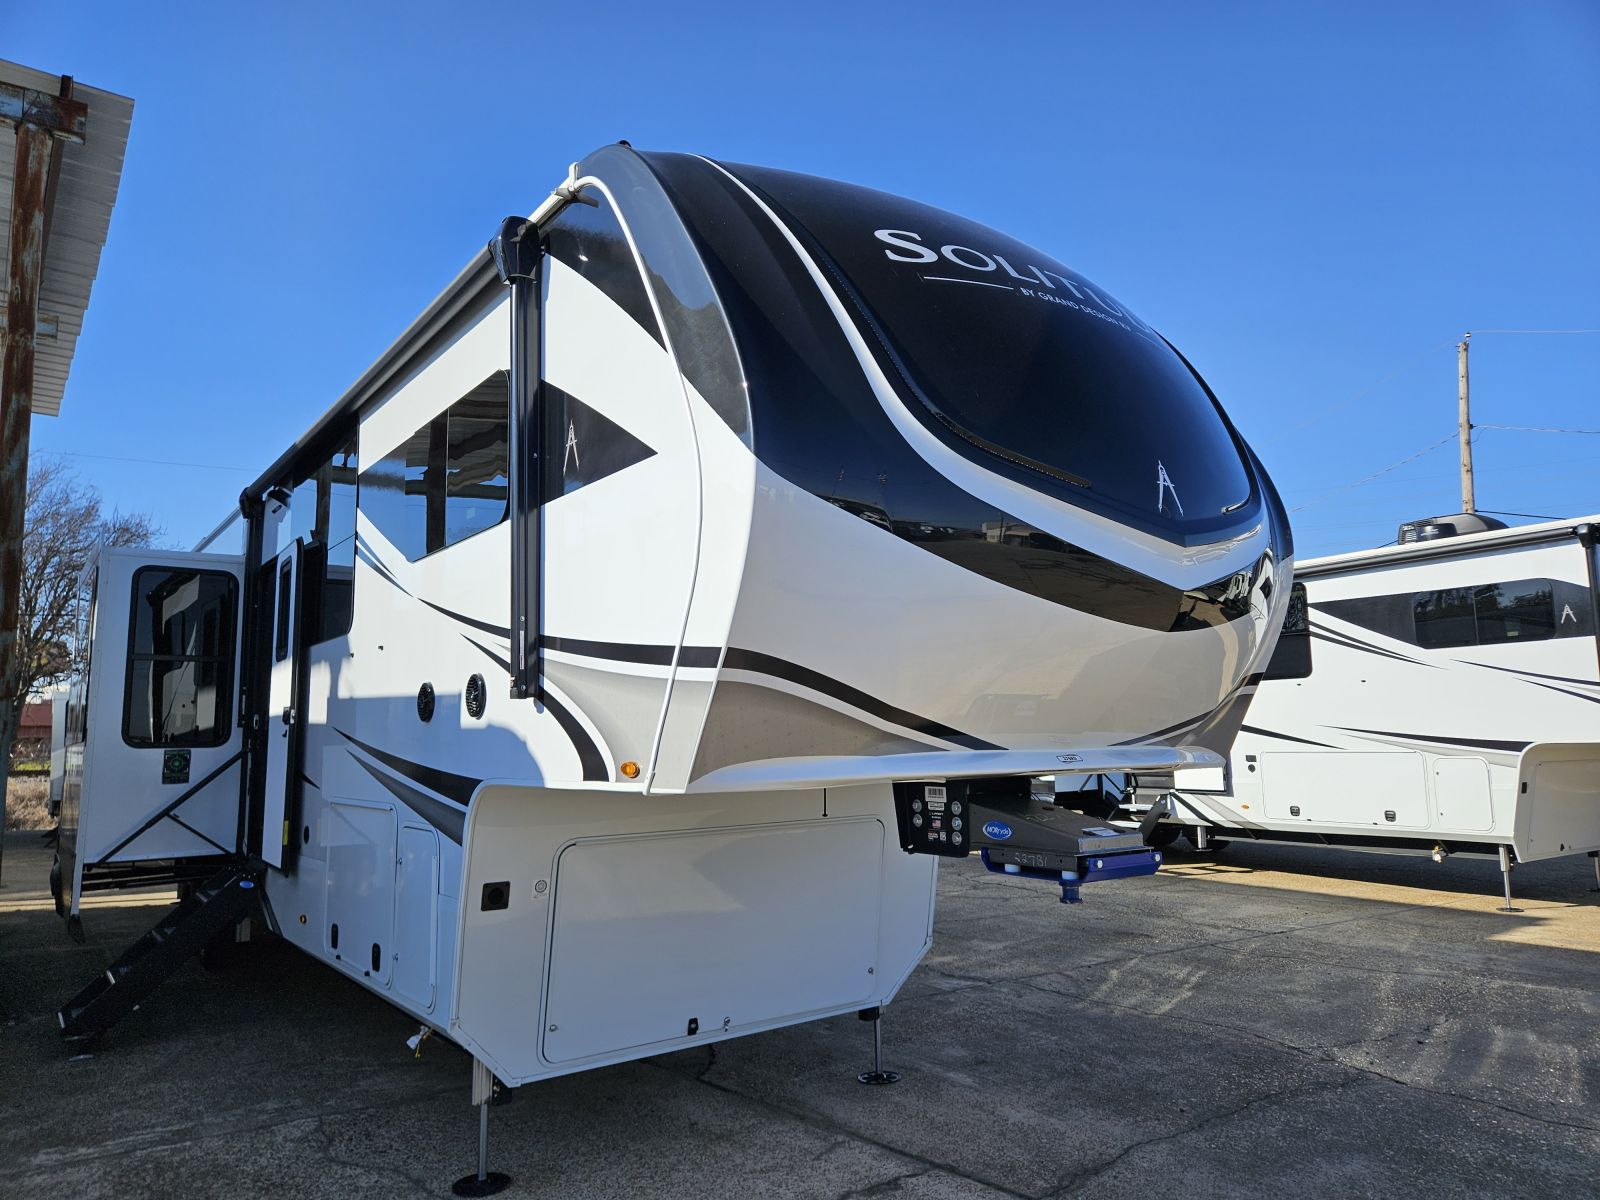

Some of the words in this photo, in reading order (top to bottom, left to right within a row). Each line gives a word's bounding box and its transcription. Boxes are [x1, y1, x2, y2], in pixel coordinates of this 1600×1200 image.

[1020, 287, 1035, 297] BY
[1037, 291, 1079, 310] GRAND
[1079, 304, 1119, 325] DESIGN
